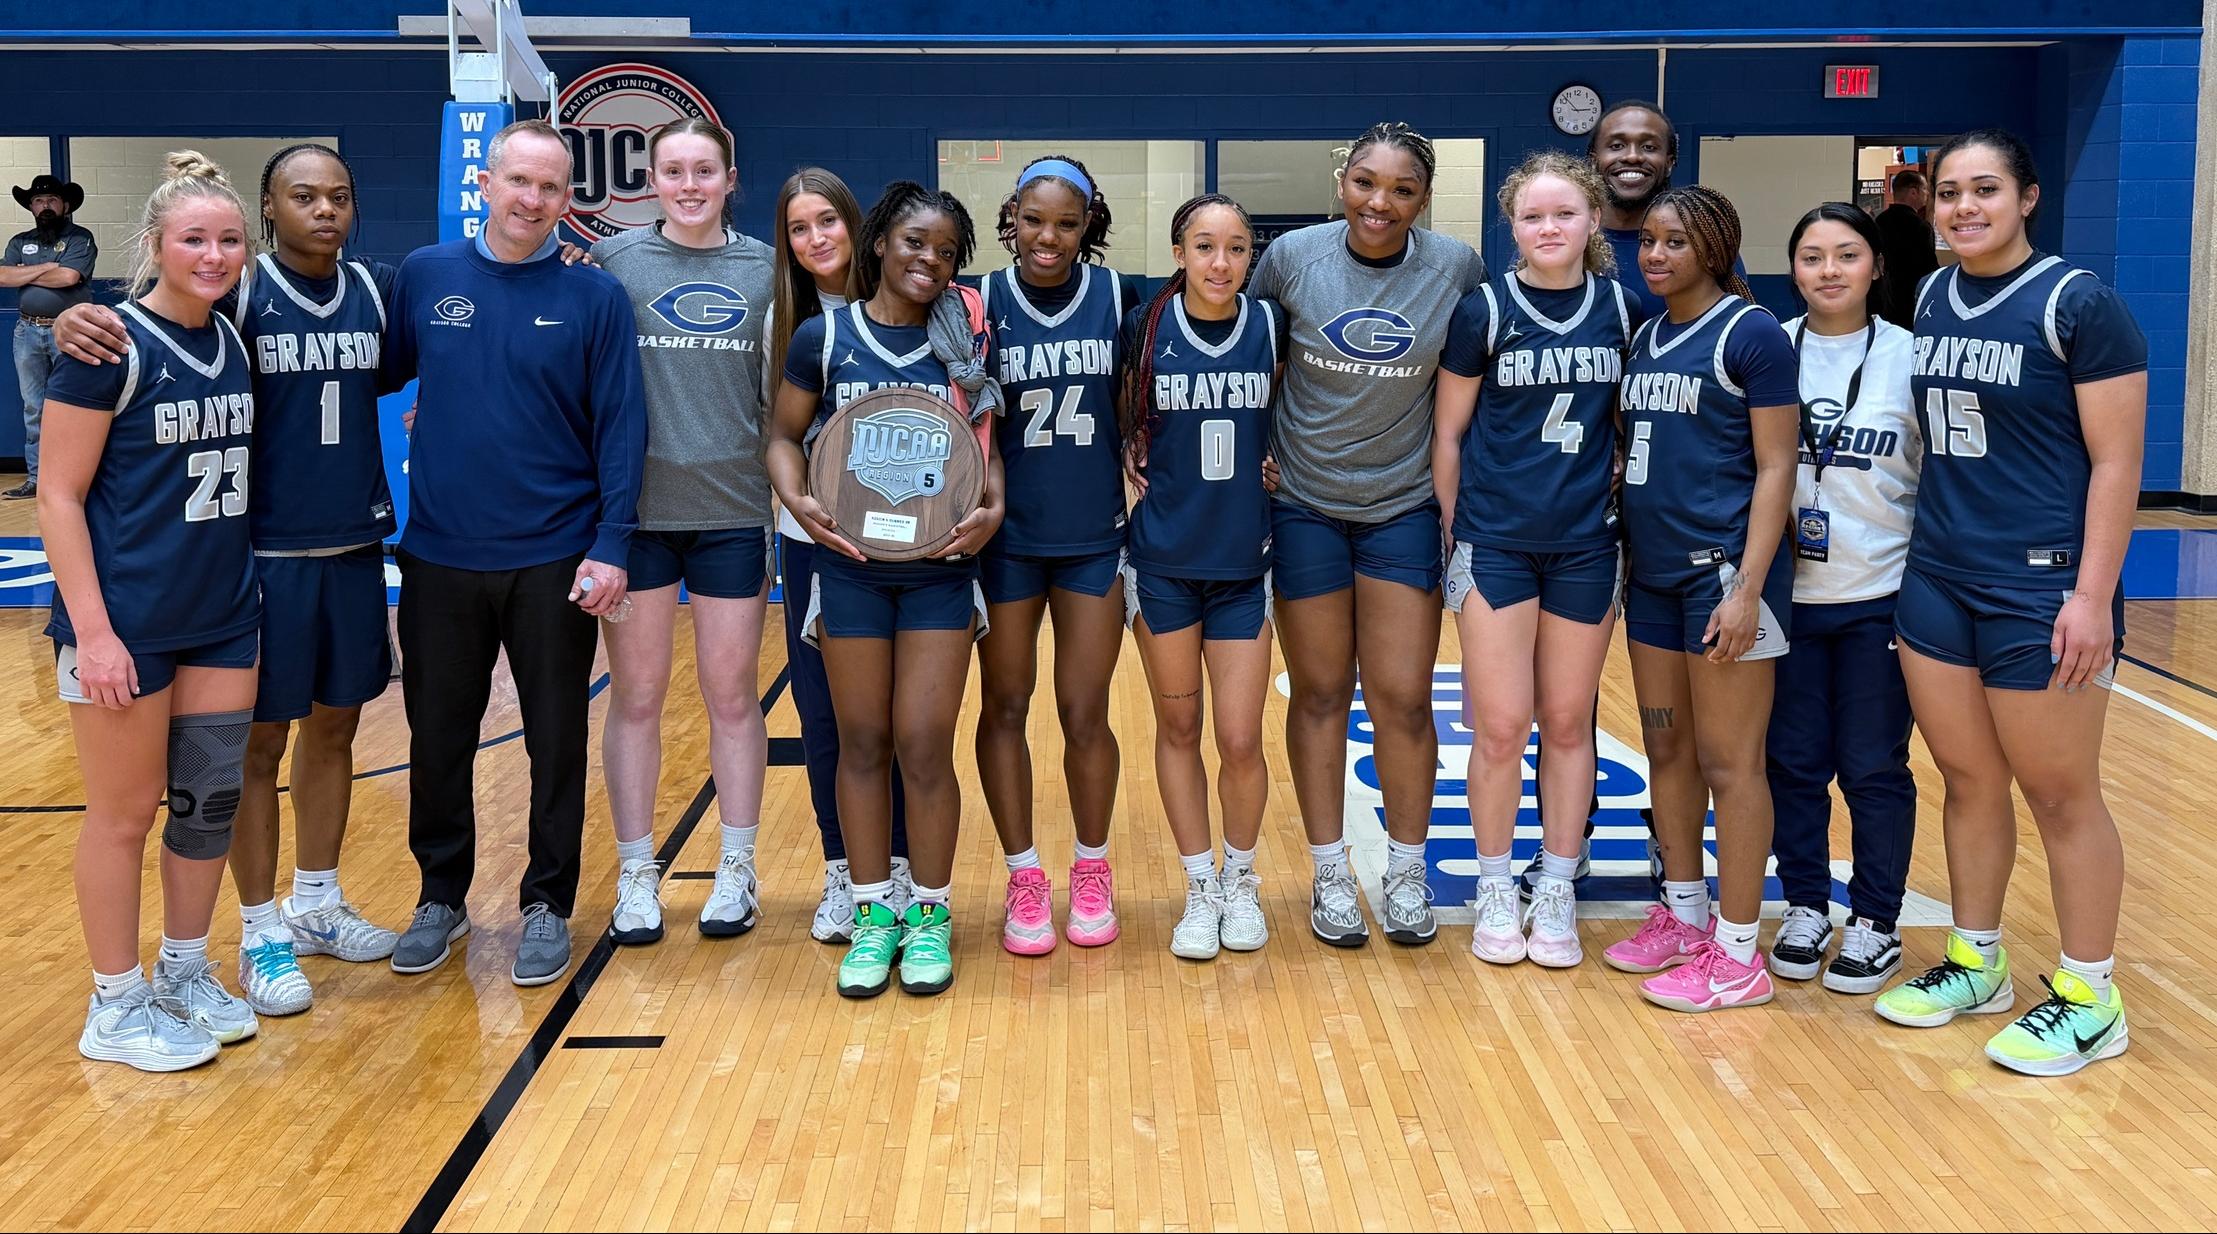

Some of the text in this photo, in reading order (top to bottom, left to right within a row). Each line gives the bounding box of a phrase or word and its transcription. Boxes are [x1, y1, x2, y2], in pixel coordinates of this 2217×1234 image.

[562, 82, 613, 118] NATIONAL
[616, 79, 658, 91] JUNIOR
[1836, 68, 1871, 97] EXIT
[256, 331, 380, 374] GRAYSON
[999, 339, 1113, 385] GRAYSON
[1303, 351, 1423, 378] BASKETBALL
[1497, 347, 1622, 387] GRAYSON
[320, 381, 340, 445] 1
[1155, 372, 1271, 411] GRAYSON
[1020, 385, 1095, 447] 24
[1541, 393, 1584, 454] 4
[1926, 387, 1988, 458] 15
[853, 423, 949, 466] NJCAA
[1200, 419, 1235, 481] 0
[1625, 421, 1652, 486] 5
[185, 446, 249, 522] 23
[869, 469, 935, 488] REGION 5
[2056, 554, 2063, 562] L
